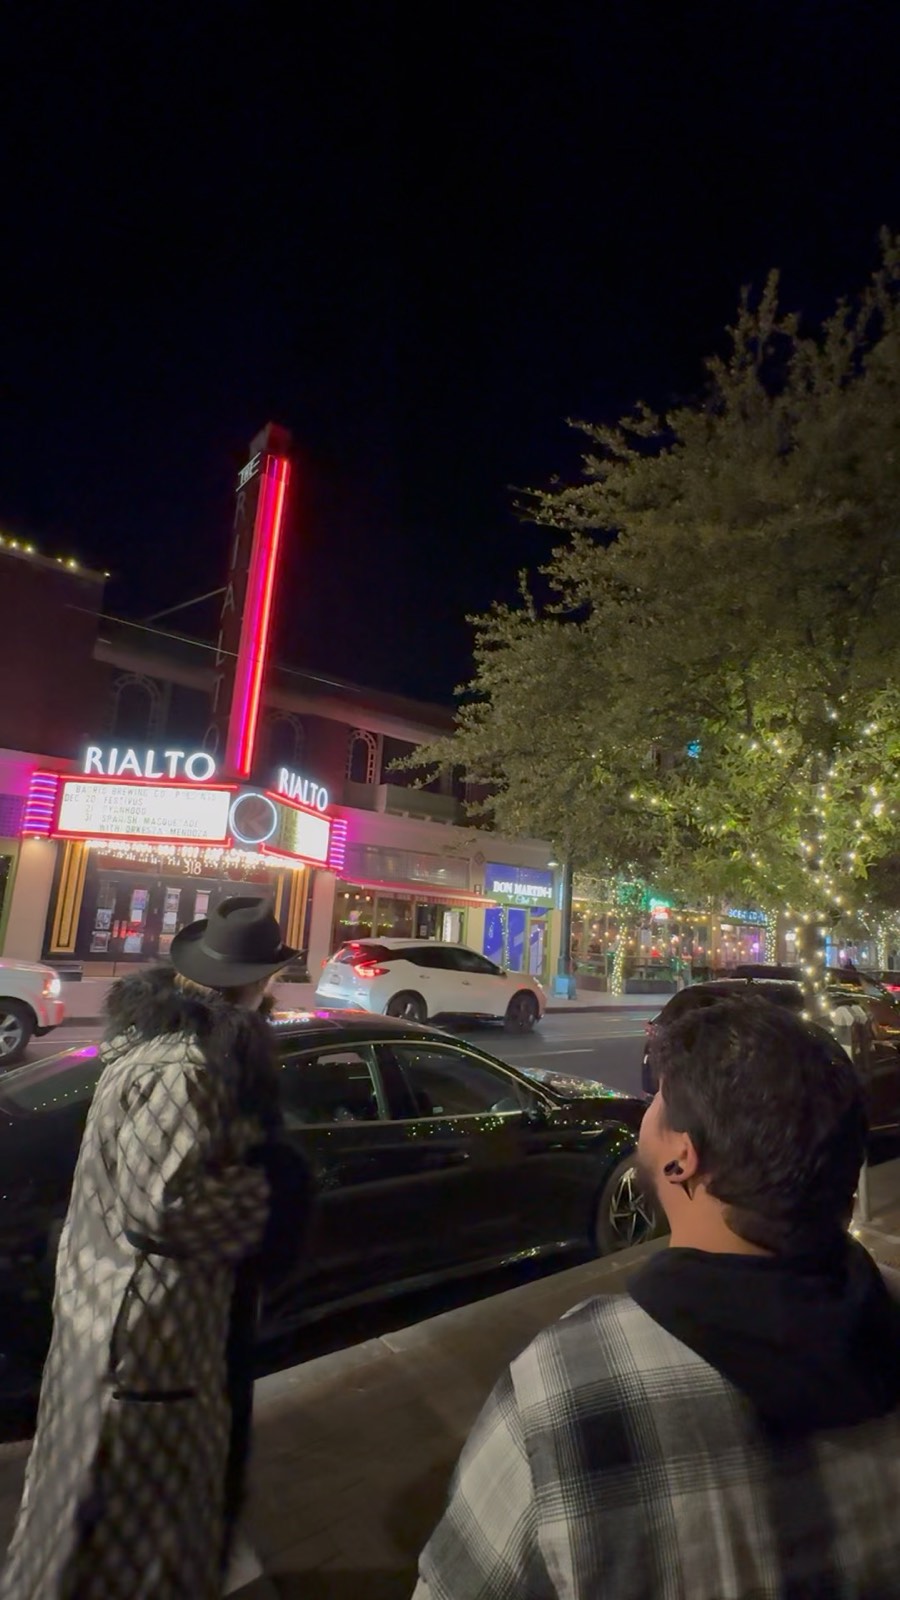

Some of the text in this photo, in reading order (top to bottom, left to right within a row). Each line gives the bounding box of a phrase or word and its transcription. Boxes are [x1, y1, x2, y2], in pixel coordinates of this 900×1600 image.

[84, 747, 216, 781] RIALTO
[278, 767, 329, 812] RIALTO
[144, 817, 199, 827] MASQUEADE
[182, 858, 202, 875] 318
[493, 880, 513, 894] DON
